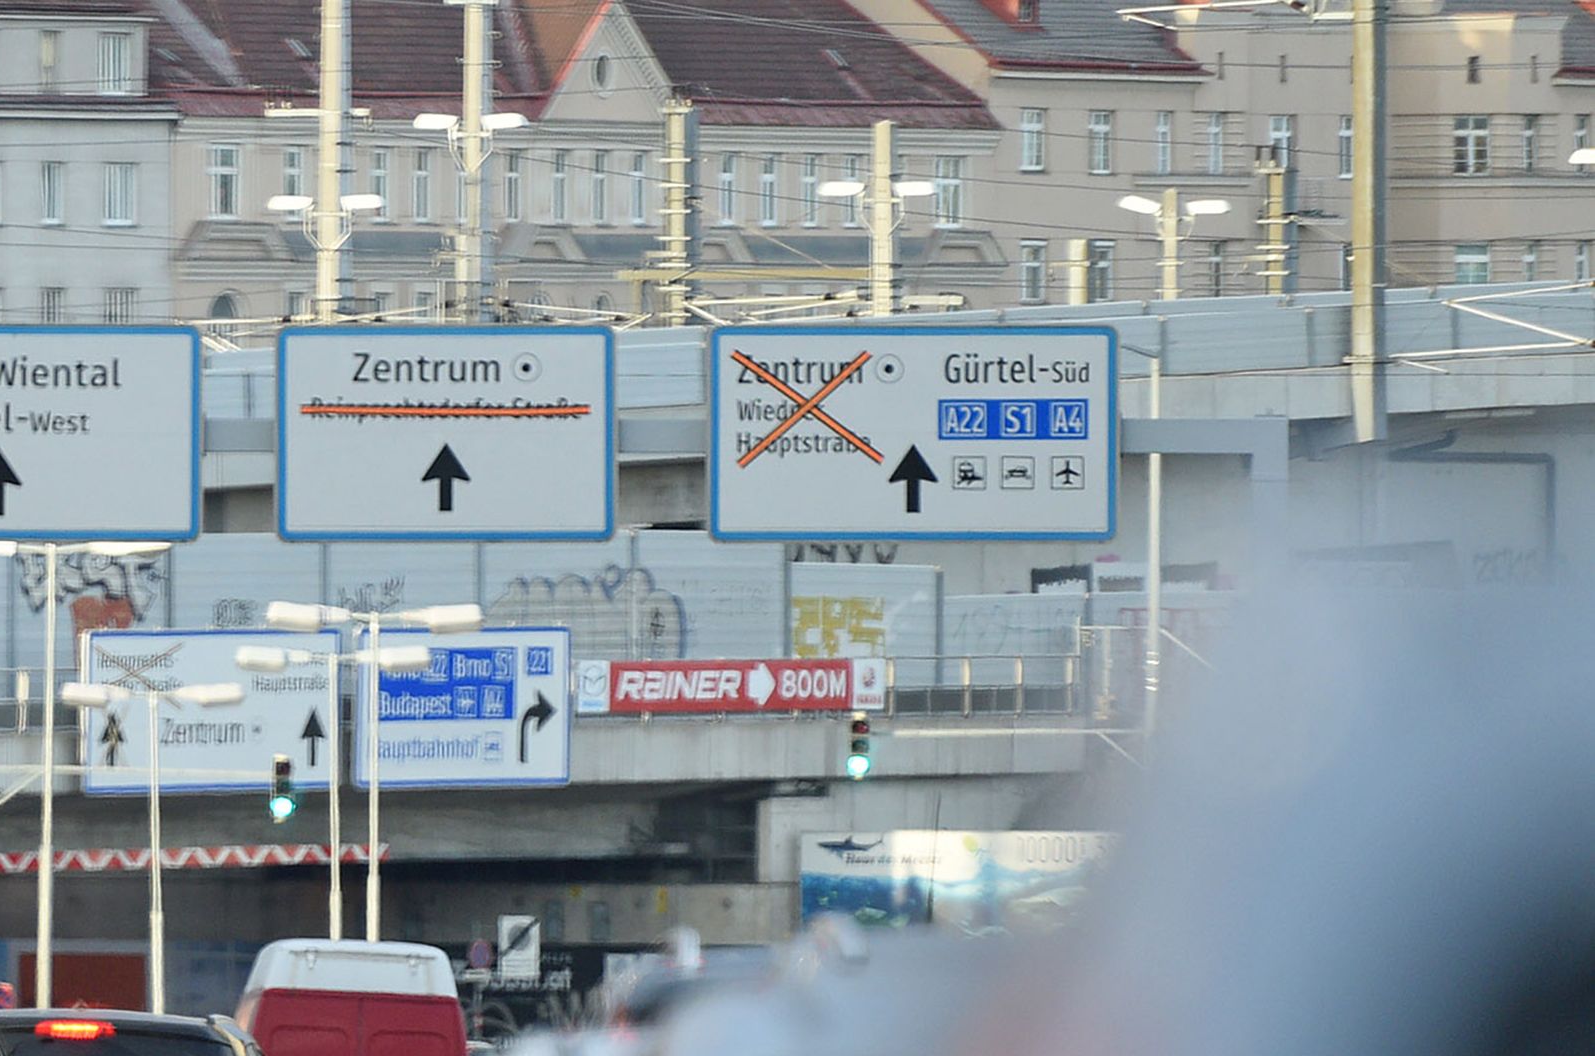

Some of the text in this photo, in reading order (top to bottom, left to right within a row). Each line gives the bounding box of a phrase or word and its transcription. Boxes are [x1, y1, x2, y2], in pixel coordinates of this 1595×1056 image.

[352, 352, 501, 382] Zentrum
[737, 355, 863, 384] Zentrum
[944, 353, 1091, 384] Gürtel-Süd
[946, 406, 1083, 434] A22 S1 A4
[529, 654, 547, 672] 221
[780, 669, 846, 699] 800M
[379, 690, 453, 718] Budapest
[160, 717, 245, 745] Zentrum
[378, 736, 479, 764] auptbahnhof
